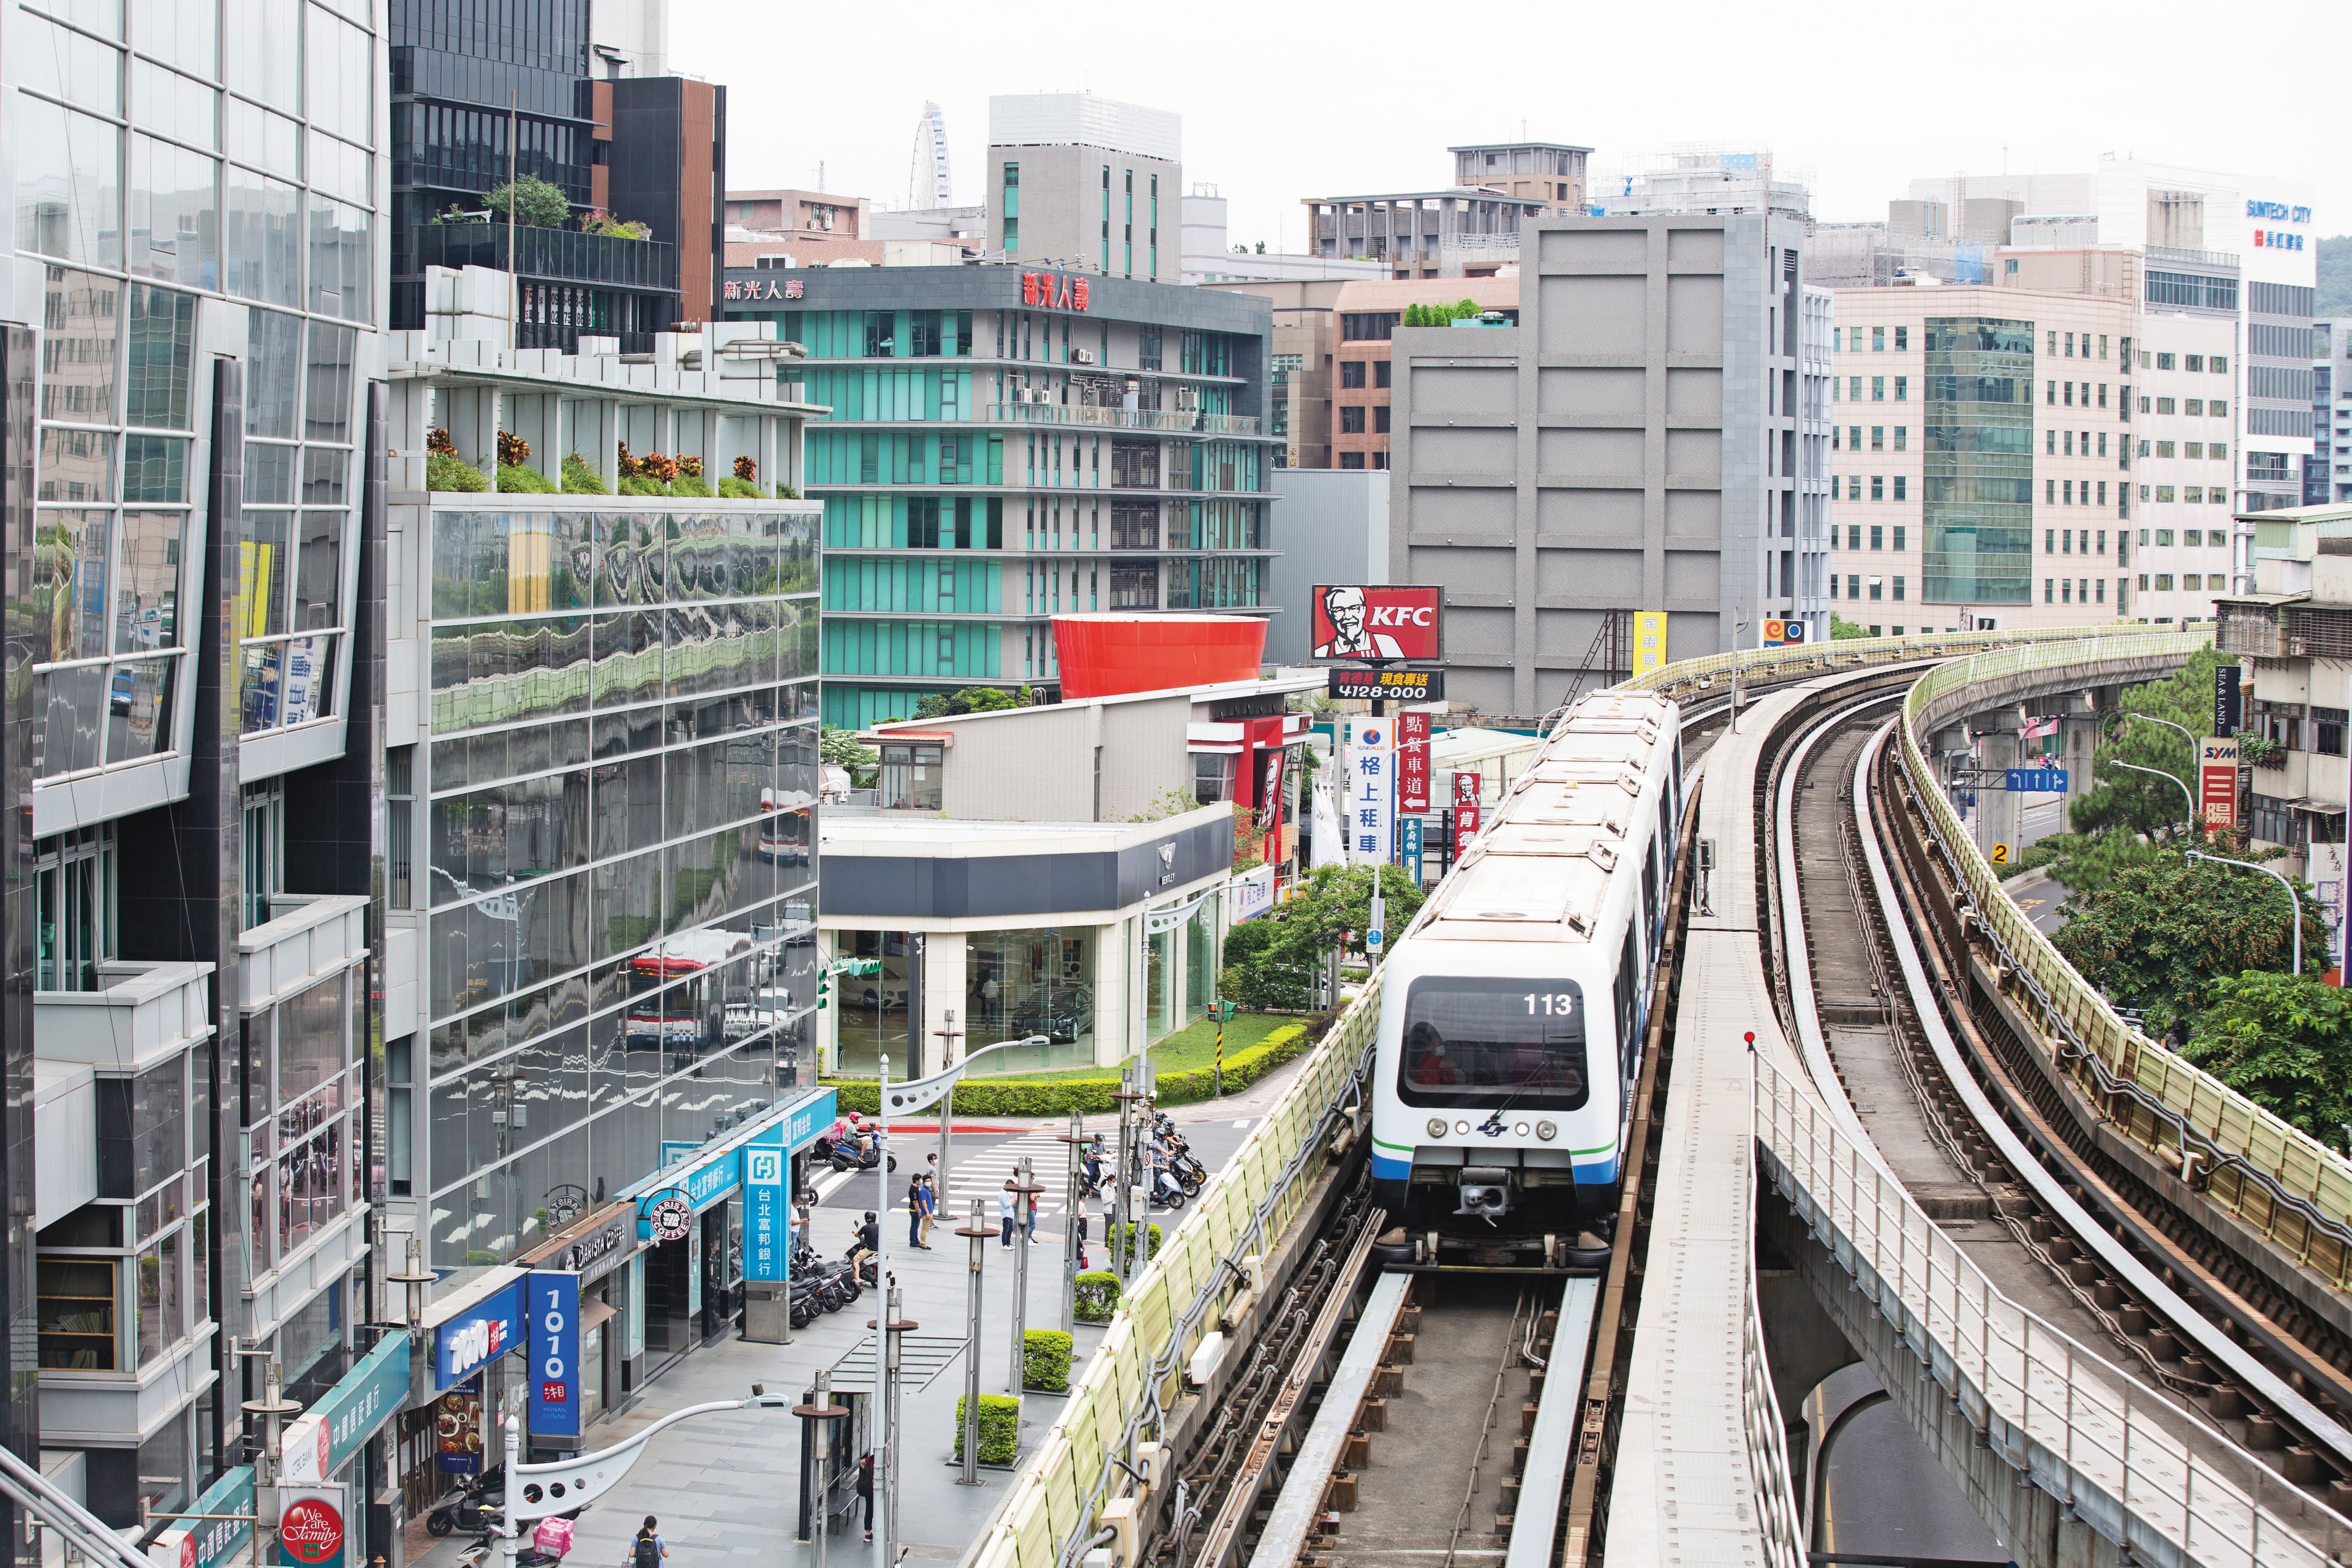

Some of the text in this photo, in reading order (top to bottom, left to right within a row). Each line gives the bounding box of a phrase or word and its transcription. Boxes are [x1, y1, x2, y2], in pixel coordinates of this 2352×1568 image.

[2247, 199, 2312, 223] SUNTECH CITY
[724, 280, 804, 300] 新光人壽
[1023, 270, 1089, 311] 新光人壽
[1369, 606, 1432, 627] KFC
[1643, 617, 1658, 675] 冠錡國
[1339, 671, 1429, 686] 肯德基 現食專送
[2218, 668, 2226, 686] SEA
[1339, 685, 1427, 699] 4128-000
[1300, 715, 1313, 731] KFC
[2217, 698, 2226, 725] LAND
[1406, 715, 1423, 794] 點餐車道
[2204, 747, 2237, 760] SYM
[1358, 756, 1382, 853] 格上租車
[1994, 845, 2007, 862] 2
[1161, 872, 1175, 886] BENTLEY
[1523, 993, 1572, 1016] 113
[792, 1113, 811, 1142] 富邦金控
[691, 1164, 724, 1204] 台北富邦銀行
[654, 1201, 688, 1219] BARISTA
[654, 1221, 689, 1238] COFFEE
[758, 1188, 771, 1276] 台北富邦銀行
[578, 1236, 605, 1268] BARISTA
[606, 1224, 625, 1250] COFFEE
[450, 1319, 489, 1374] 1010
[544, 1385, 564, 1400] 湘
[333, 1383, 379, 1449] 中國信託銀行
[293, 1445, 313, 1476] CTBC BANK
[301, 1508, 322, 1521] We
[310, 1519, 329, 1530] are
[282, 1519, 344, 1550] Family
